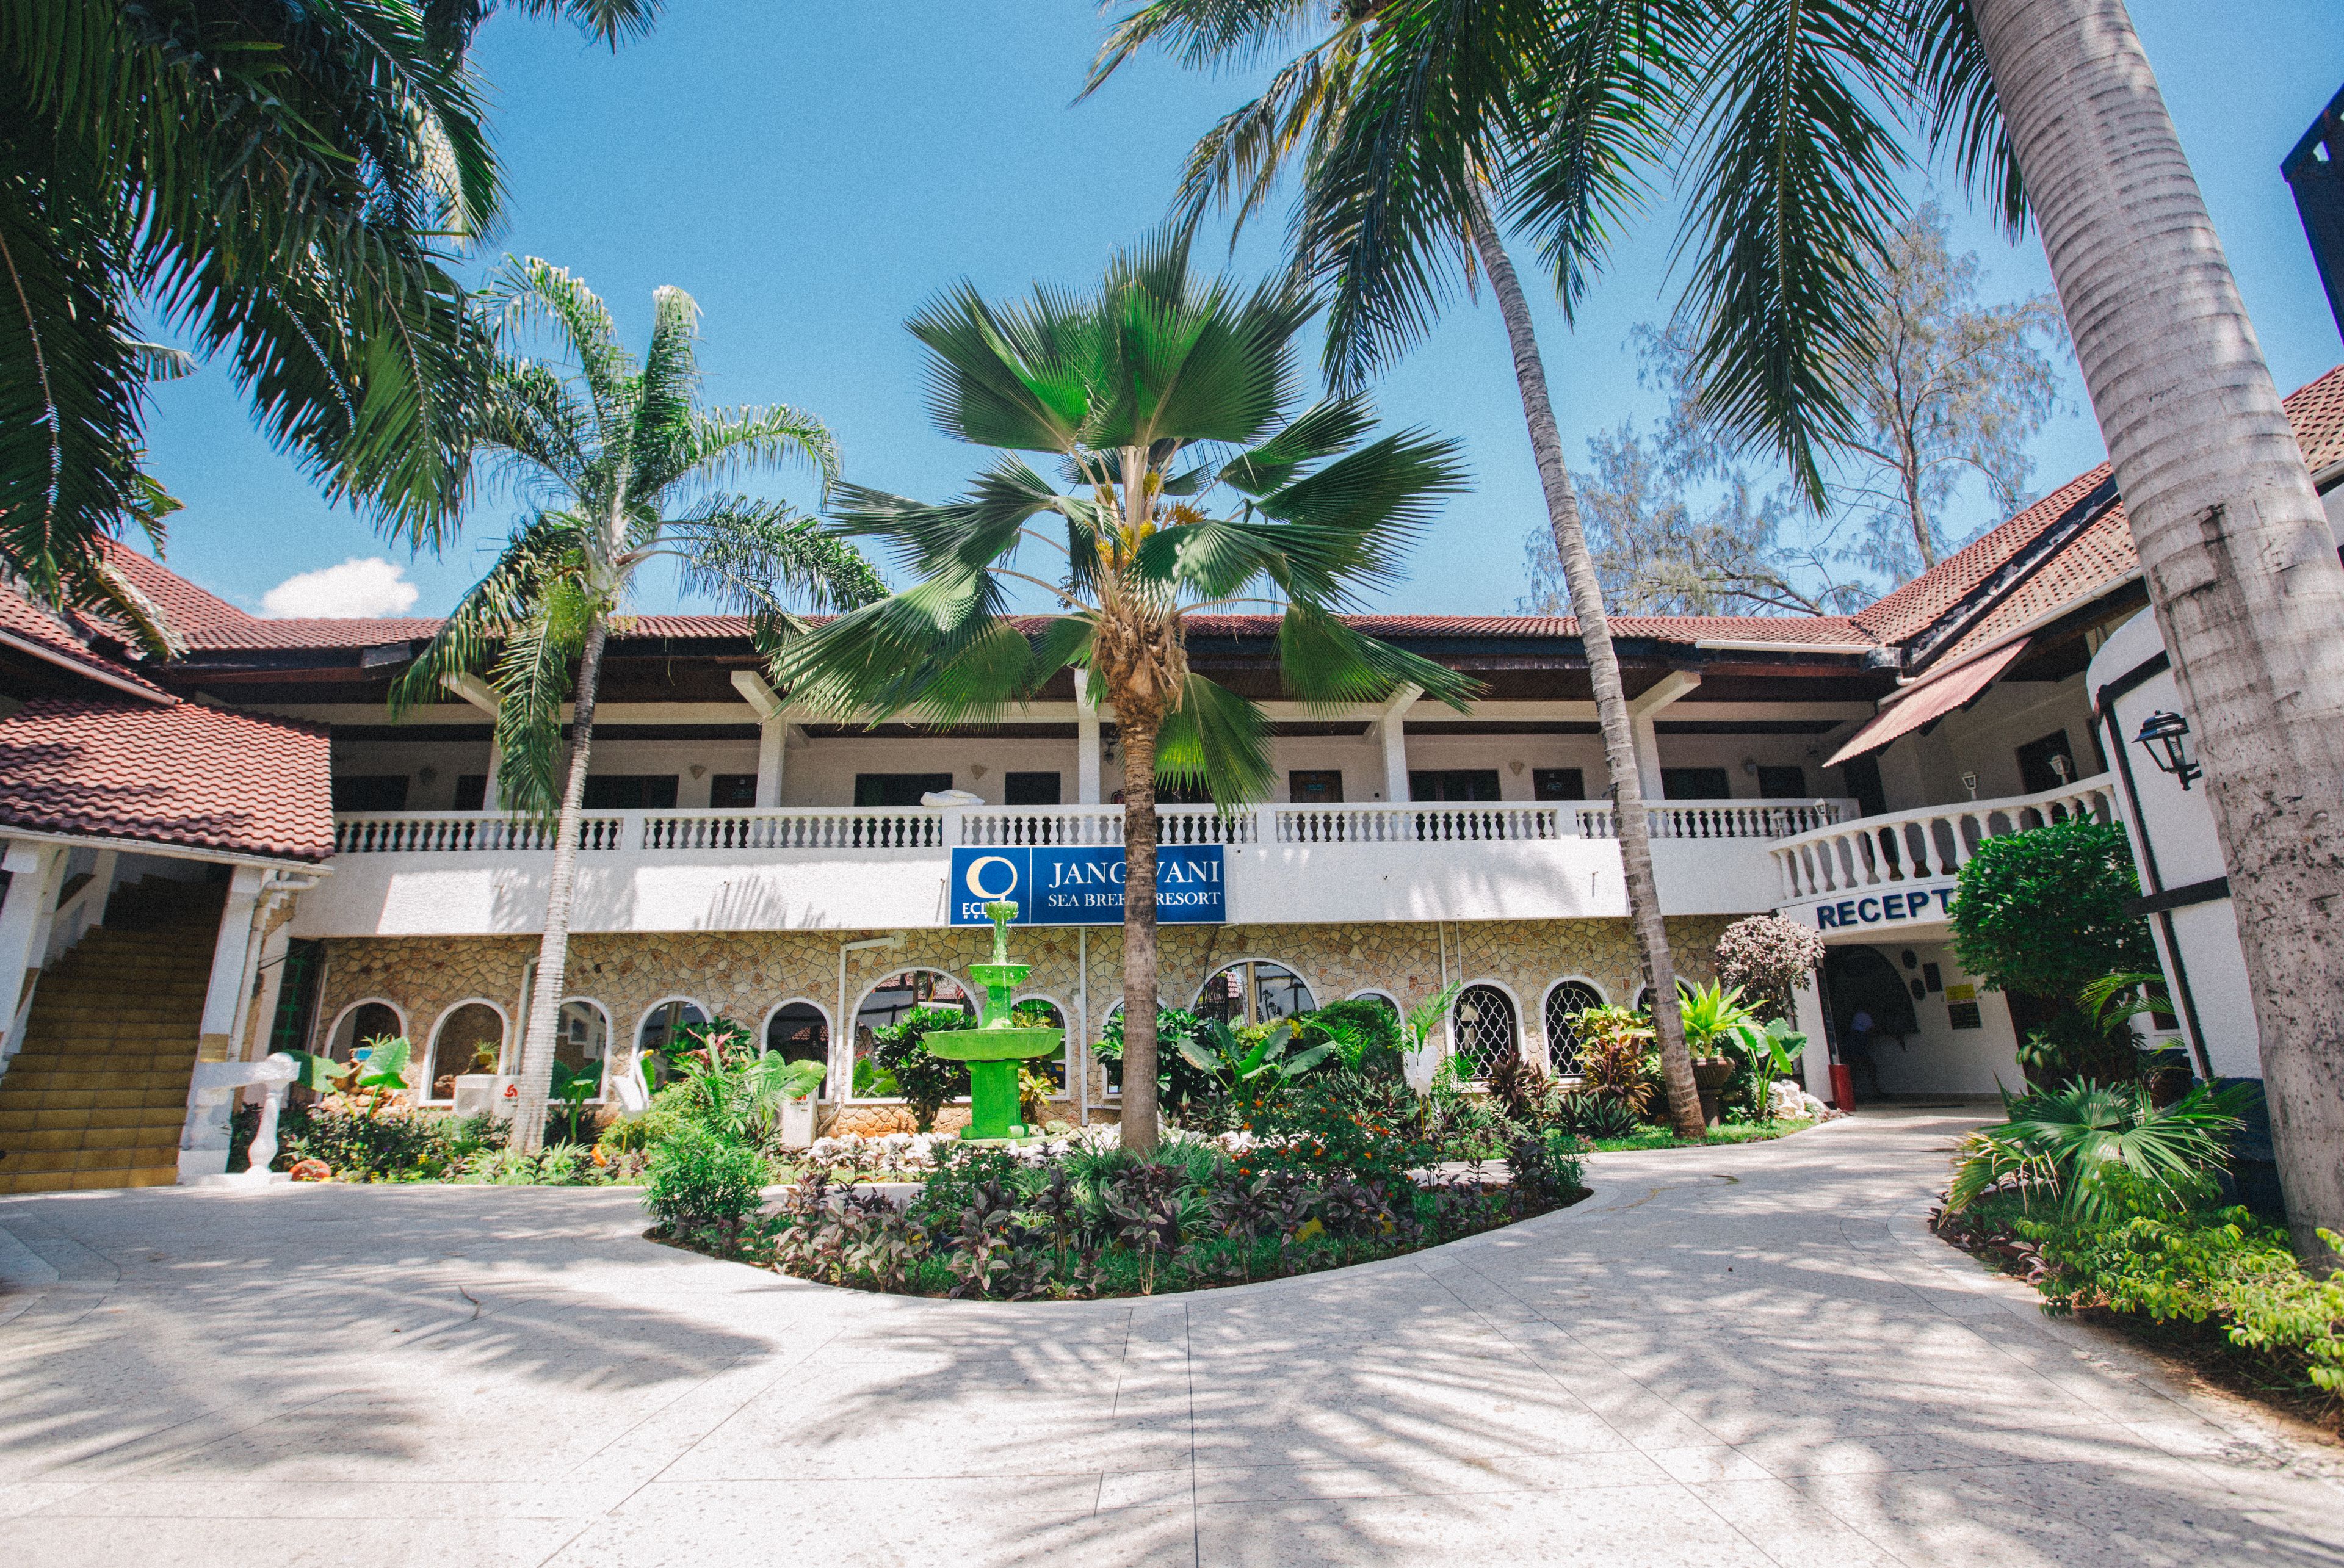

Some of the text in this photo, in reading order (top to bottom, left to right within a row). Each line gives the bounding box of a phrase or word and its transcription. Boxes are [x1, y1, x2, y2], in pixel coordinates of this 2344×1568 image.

[1049, 861, 1220, 889] JANGANI
[1048, 894, 1080, 907] SEA
[1156, 892, 1221, 905] RESORT
[1816, 888, 1953, 930] RECEPT
